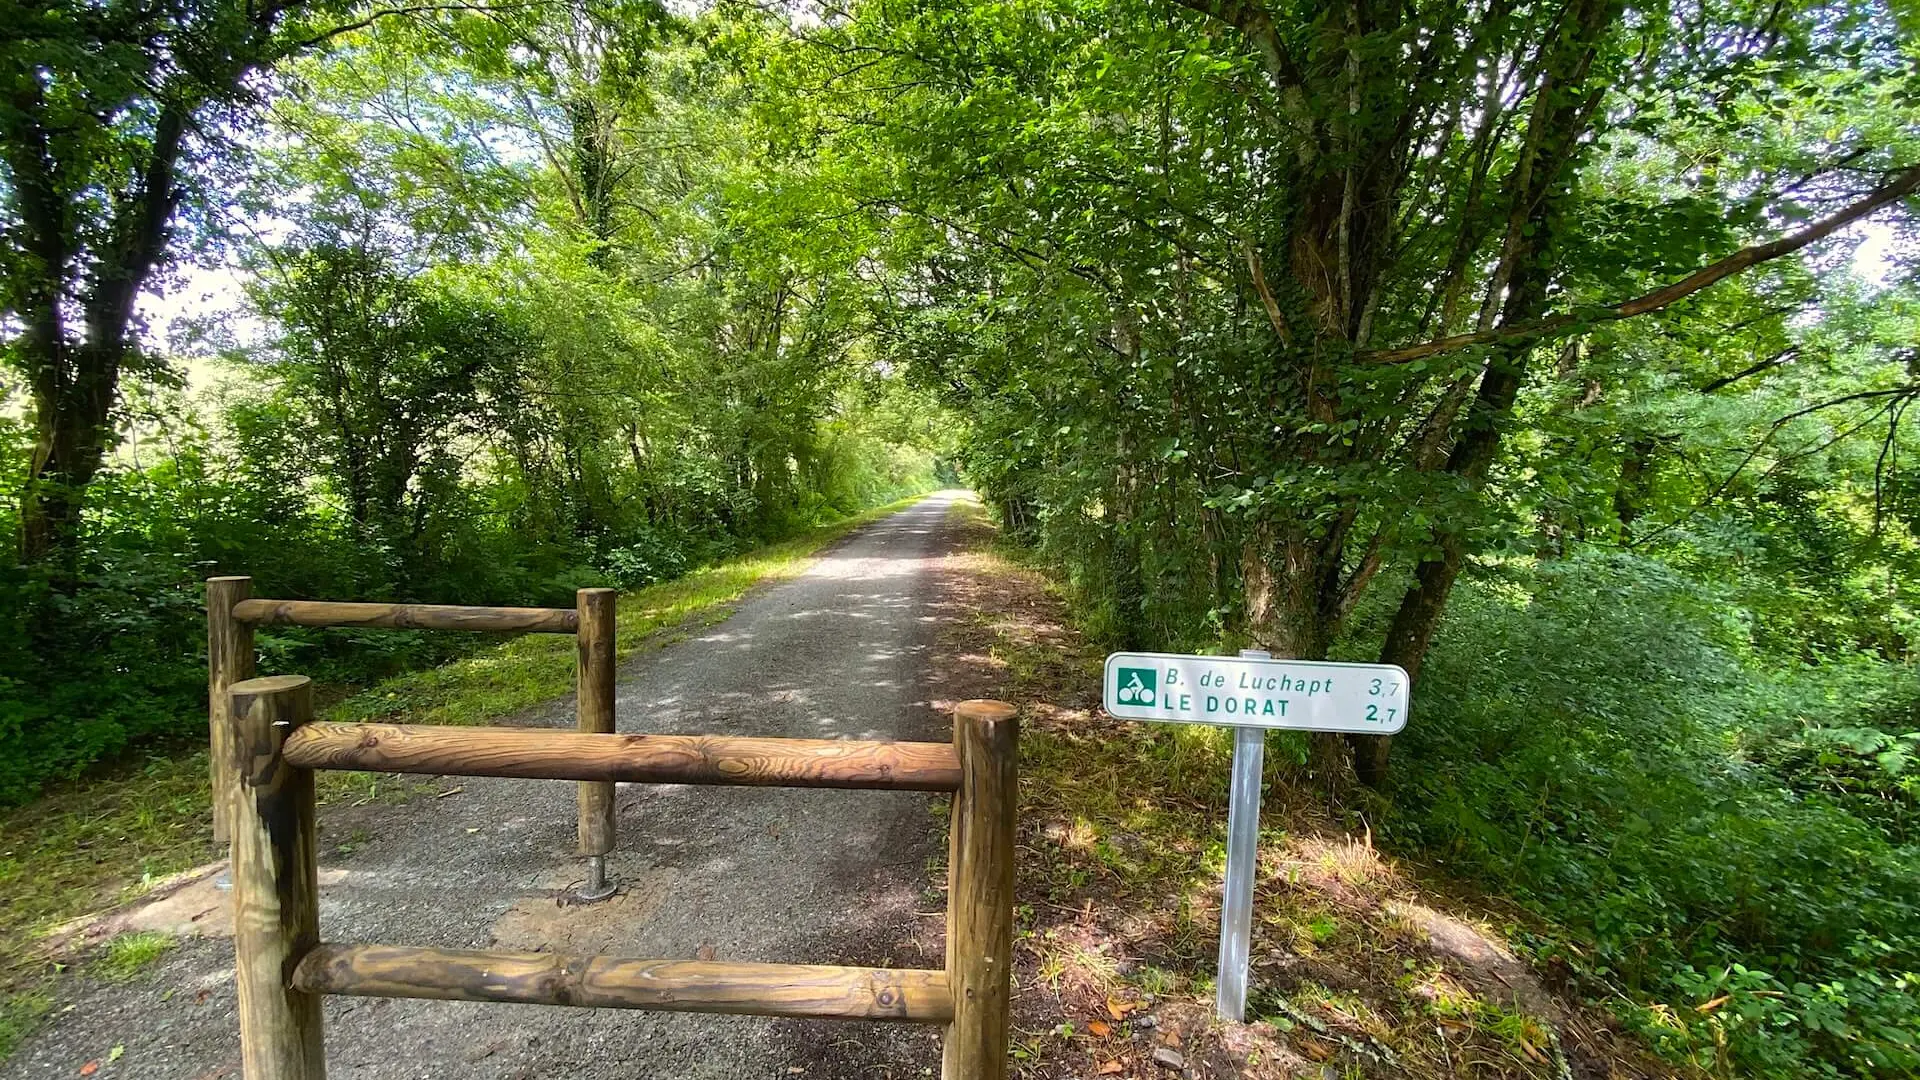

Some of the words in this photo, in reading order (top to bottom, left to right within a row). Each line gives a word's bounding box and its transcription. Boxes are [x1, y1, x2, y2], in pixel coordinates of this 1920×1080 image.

[1165, 667, 1185, 686] B.
[1200, 670, 1225, 688] de
[1239, 672, 1333, 696] Luchapt
[1368, 678, 1400, 698] 3,7
[1164, 693, 1191, 711] LE
[1207, 696, 1289, 717] DORAT
[1366, 705, 1397, 724] 2,7
